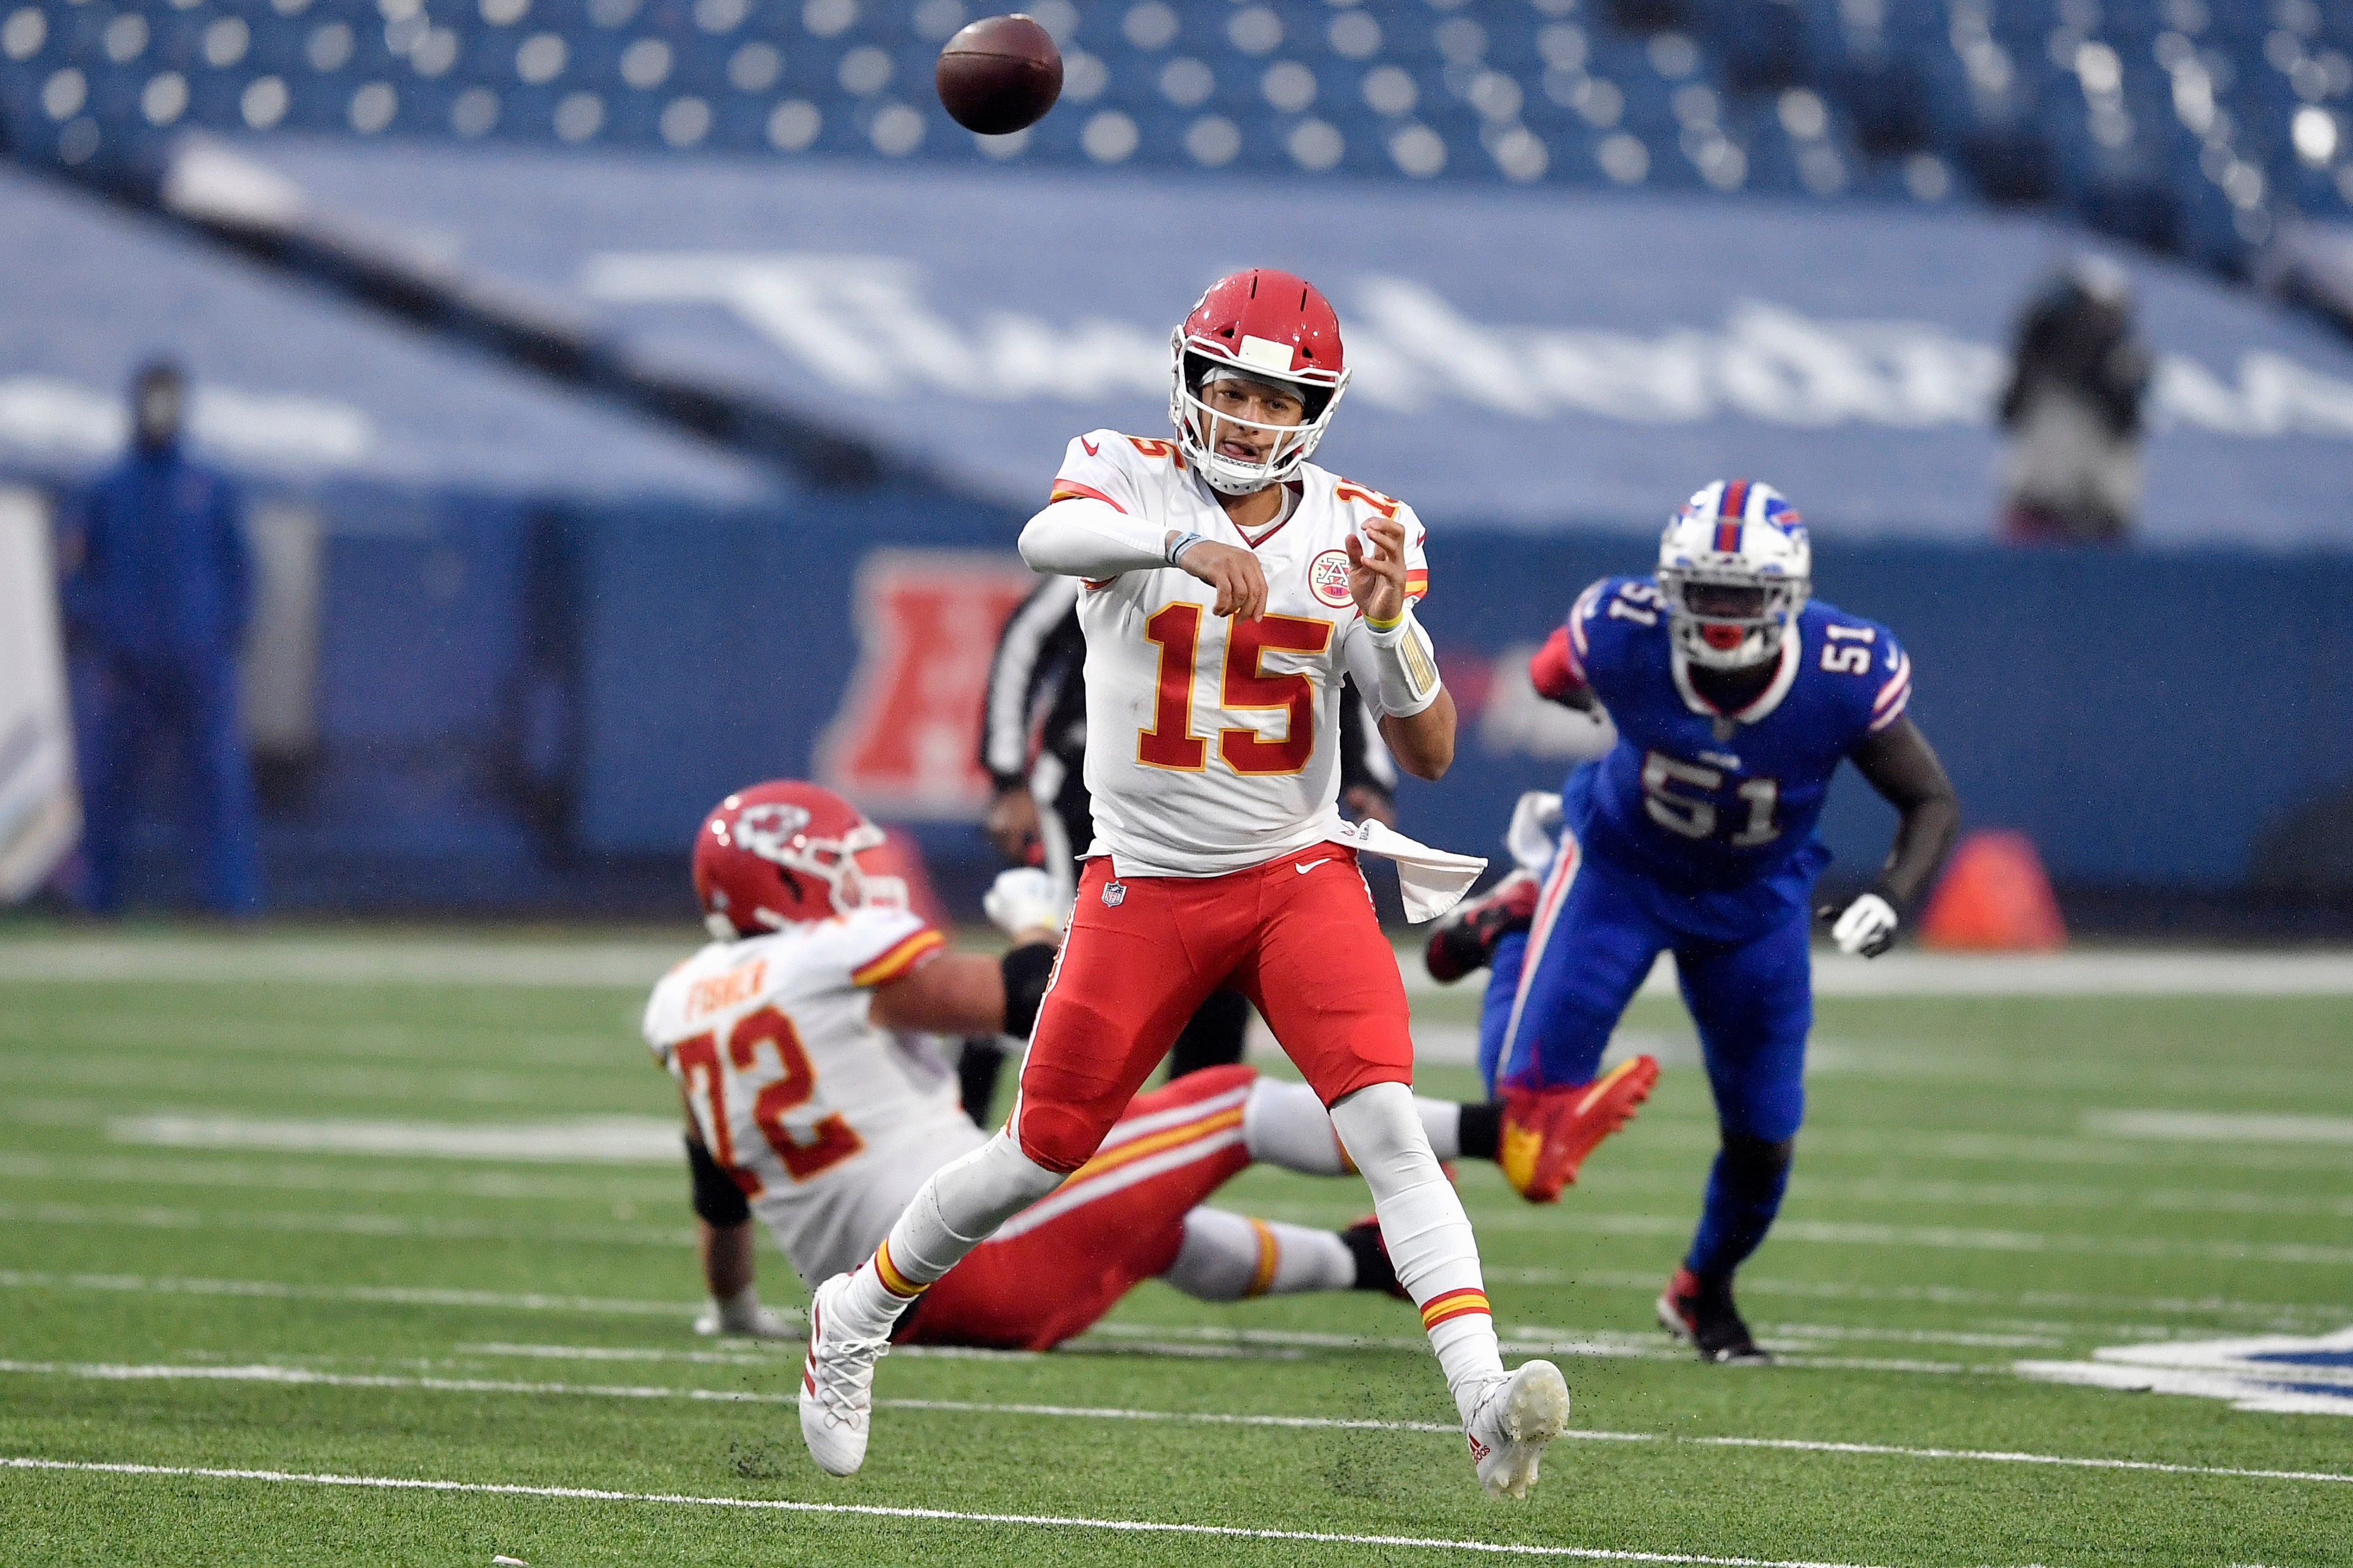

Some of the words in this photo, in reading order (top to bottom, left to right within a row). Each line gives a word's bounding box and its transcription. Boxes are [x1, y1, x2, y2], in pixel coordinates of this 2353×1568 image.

[1125, 434, 1188, 471] 5
[1333, 476, 1401, 521] 1
[1608, 582, 1666, 626] 51
[1820, 624, 1877, 675] 51
[1136, 600, 1335, 776] 15
[1641, 750, 1779, 847] 51
[675, 1004, 866, 1200] 72
